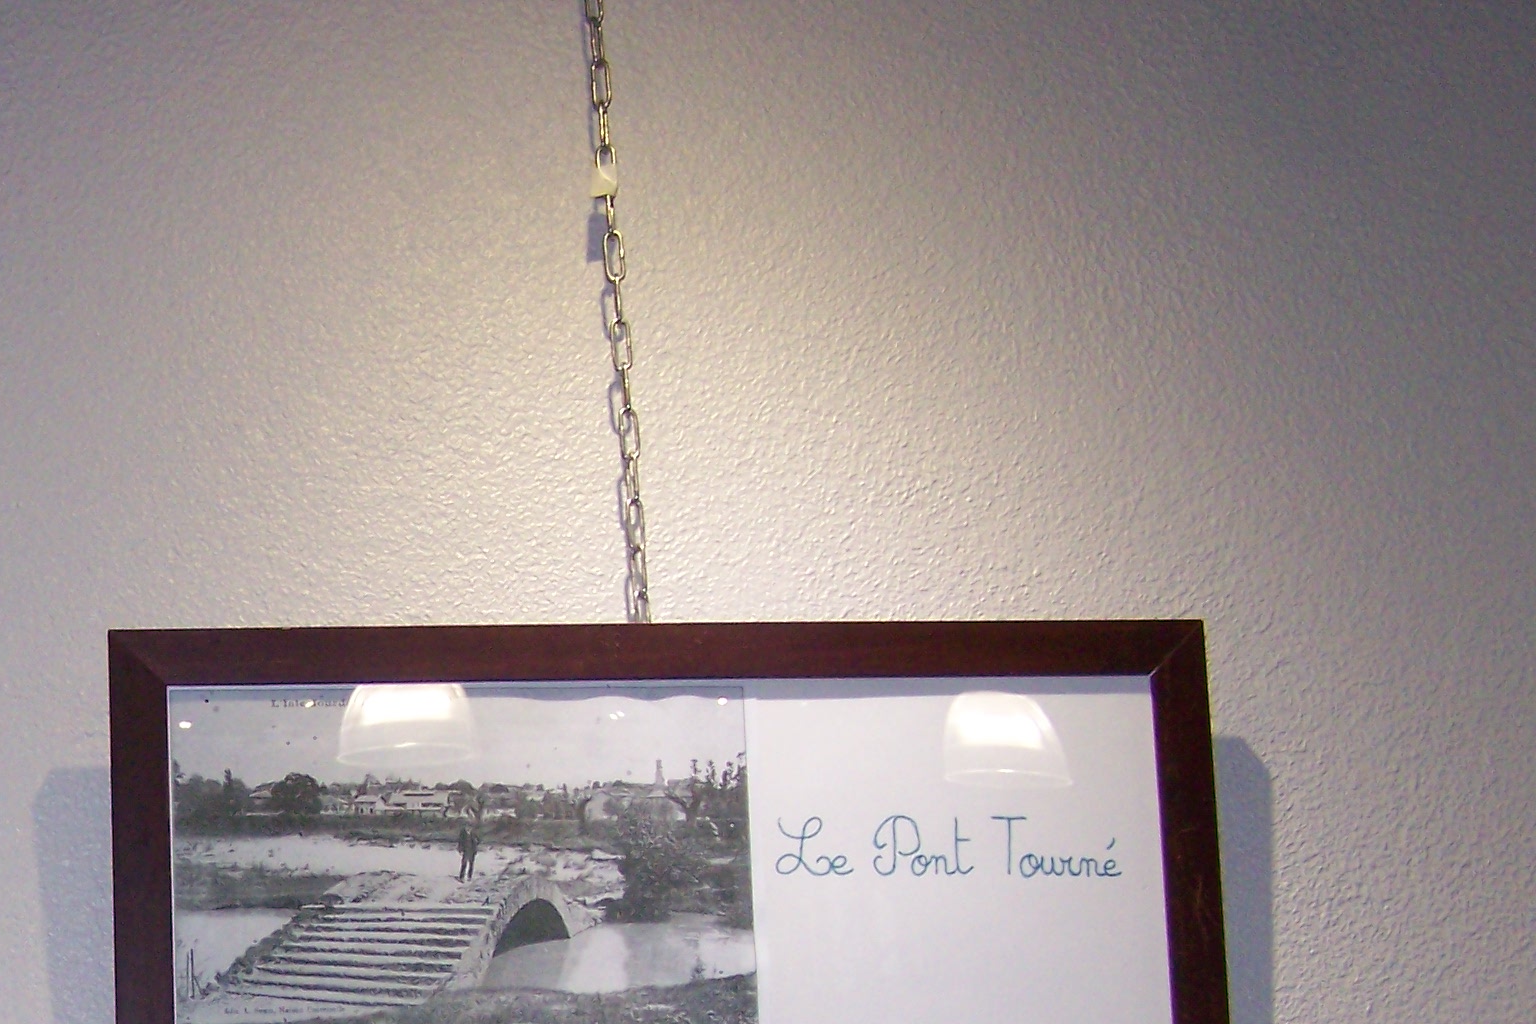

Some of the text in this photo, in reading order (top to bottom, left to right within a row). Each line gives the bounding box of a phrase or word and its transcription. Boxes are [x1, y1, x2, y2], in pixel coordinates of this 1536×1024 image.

[775, 814, 1123, 878] Le Pont Tourné
